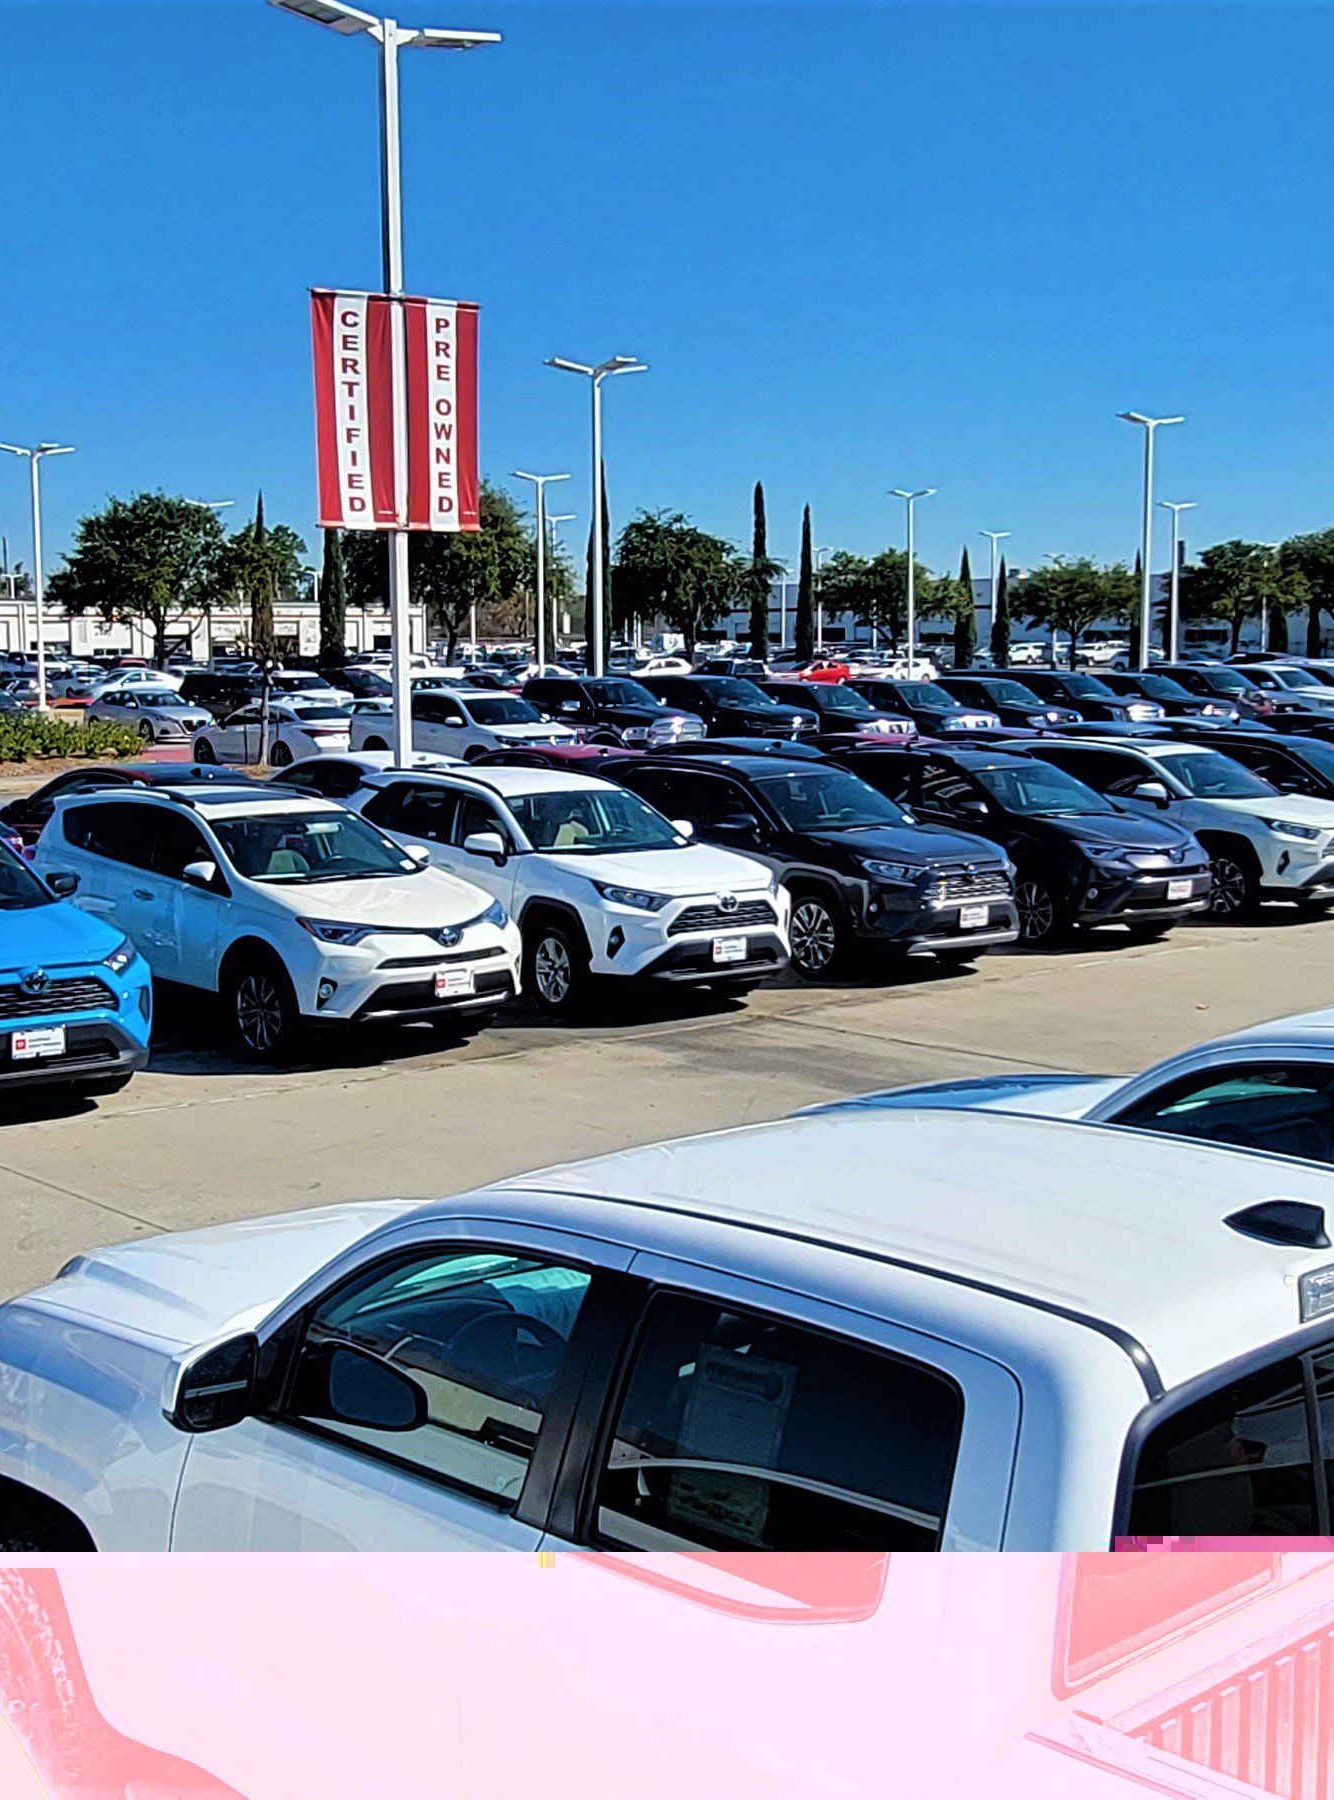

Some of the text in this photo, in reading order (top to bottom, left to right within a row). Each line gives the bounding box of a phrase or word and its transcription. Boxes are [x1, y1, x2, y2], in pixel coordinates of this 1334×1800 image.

[340, 311, 366, 513] CERTIFIED
[434, 317, 453, 513] PRE OWNED
